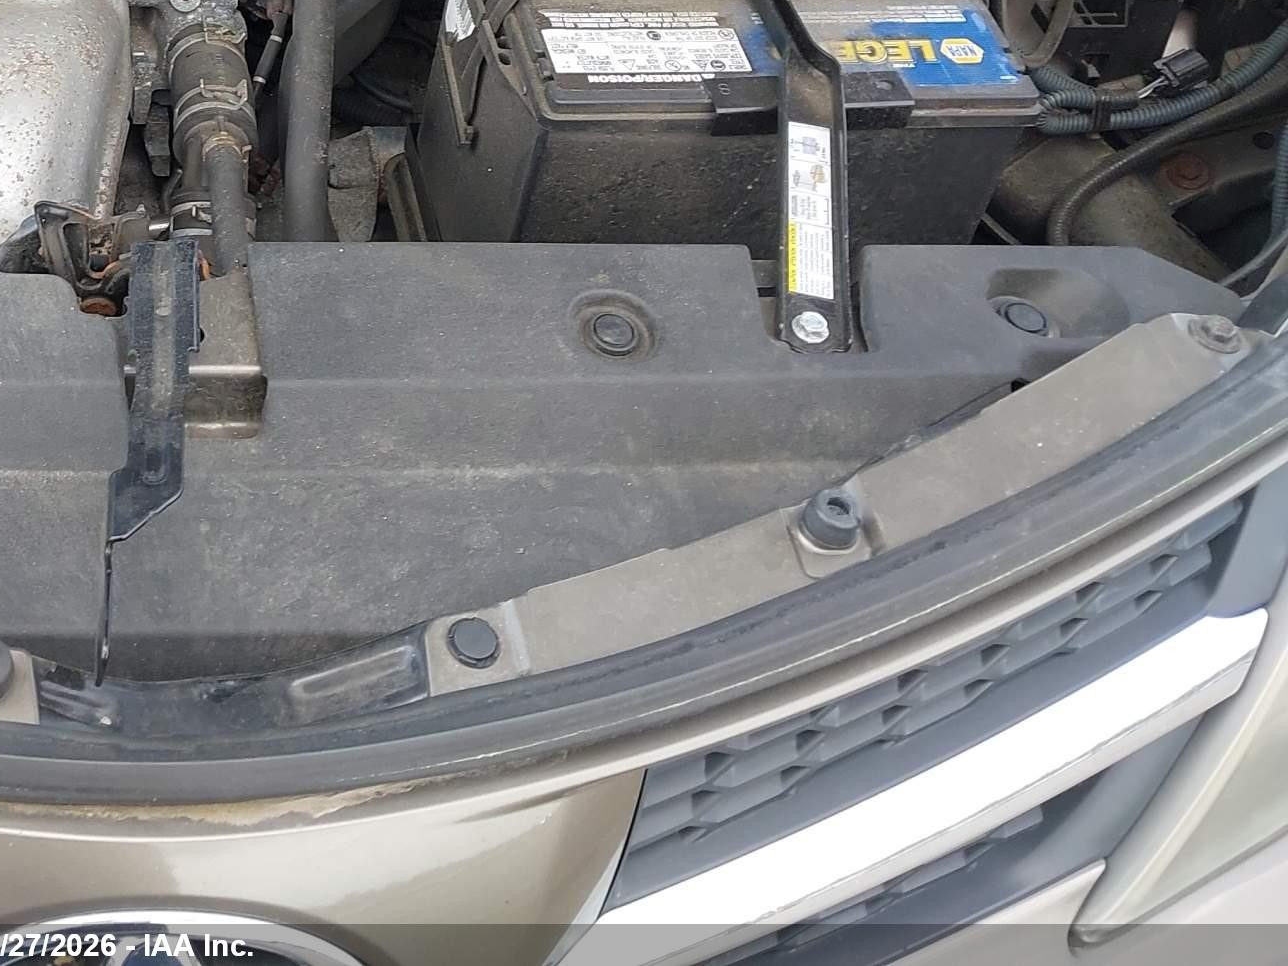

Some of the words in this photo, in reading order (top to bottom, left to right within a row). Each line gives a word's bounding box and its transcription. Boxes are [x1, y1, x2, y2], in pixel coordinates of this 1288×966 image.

[833, 39, 938, 64] LEGE
[948, 45, 977, 57] NAPA
[587, 74, 703, 83] DANGER/POISON
